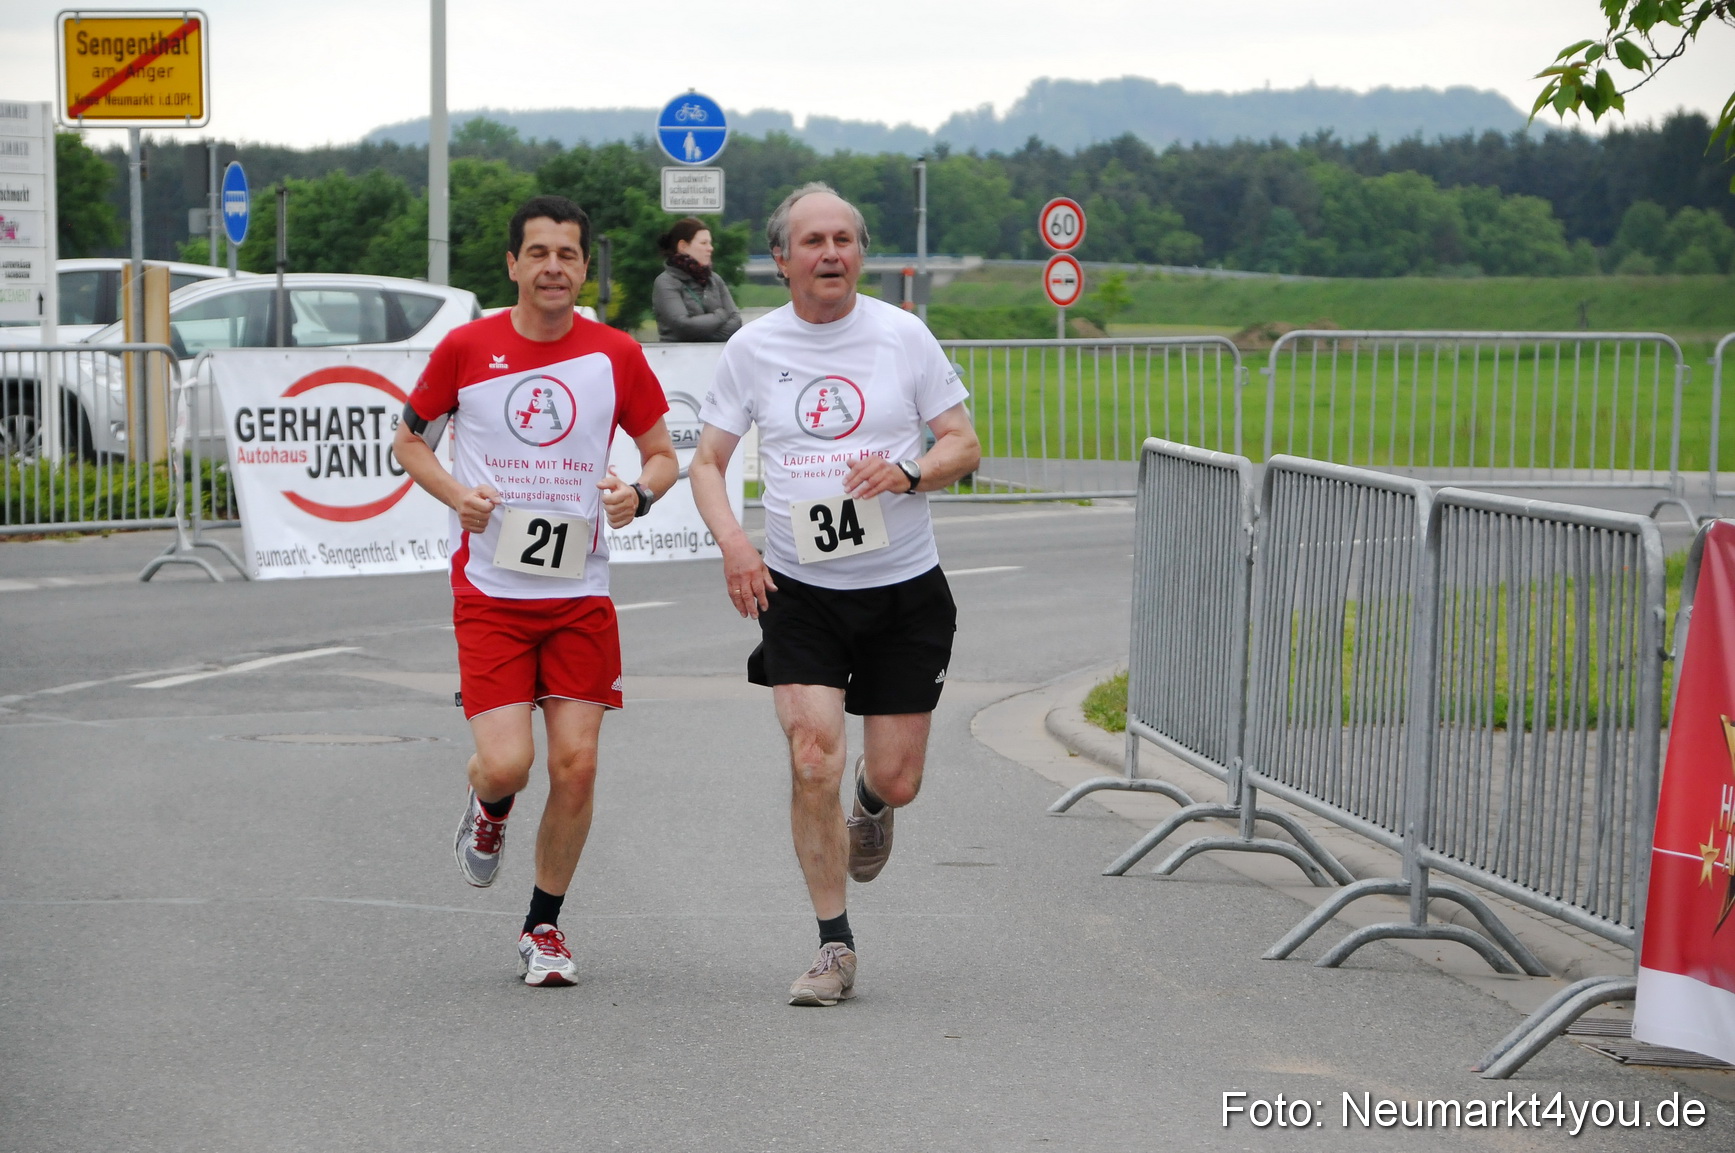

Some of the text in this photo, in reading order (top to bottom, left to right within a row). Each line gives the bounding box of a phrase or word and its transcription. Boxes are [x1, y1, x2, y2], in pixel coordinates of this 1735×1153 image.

[77, 30, 190, 62] Sengenthal
[92, 64, 175, 82] am Anger
[104, 92, 154, 106] Neumarkt
[673, 174, 712, 184] Landwirt-
[1051, 213, 1075, 236] 60
[235, 405, 399, 443] GERHART &
[237, 446, 308, 465] Autohaus
[494, 474, 506, 484] Dr.
[508, 475, 531, 484] Heck
[539, 476, 552, 485] Dr.
[554, 475, 582, 487] Röschl
[791, 471, 802, 479] Dr.
[804, 469, 826, 478] Heck
[500, 489, 581, 502] eistungsdiagnostik
[809, 498, 865, 553] 34
[520, 517, 569, 569] 21
[608, 526, 716, 556] rhart-jaenig.d
[256, 543, 312, 568] eumarkt
[318, 540, 398, 569] Sengenthal
[408, 538, 436, 561] Tel.
